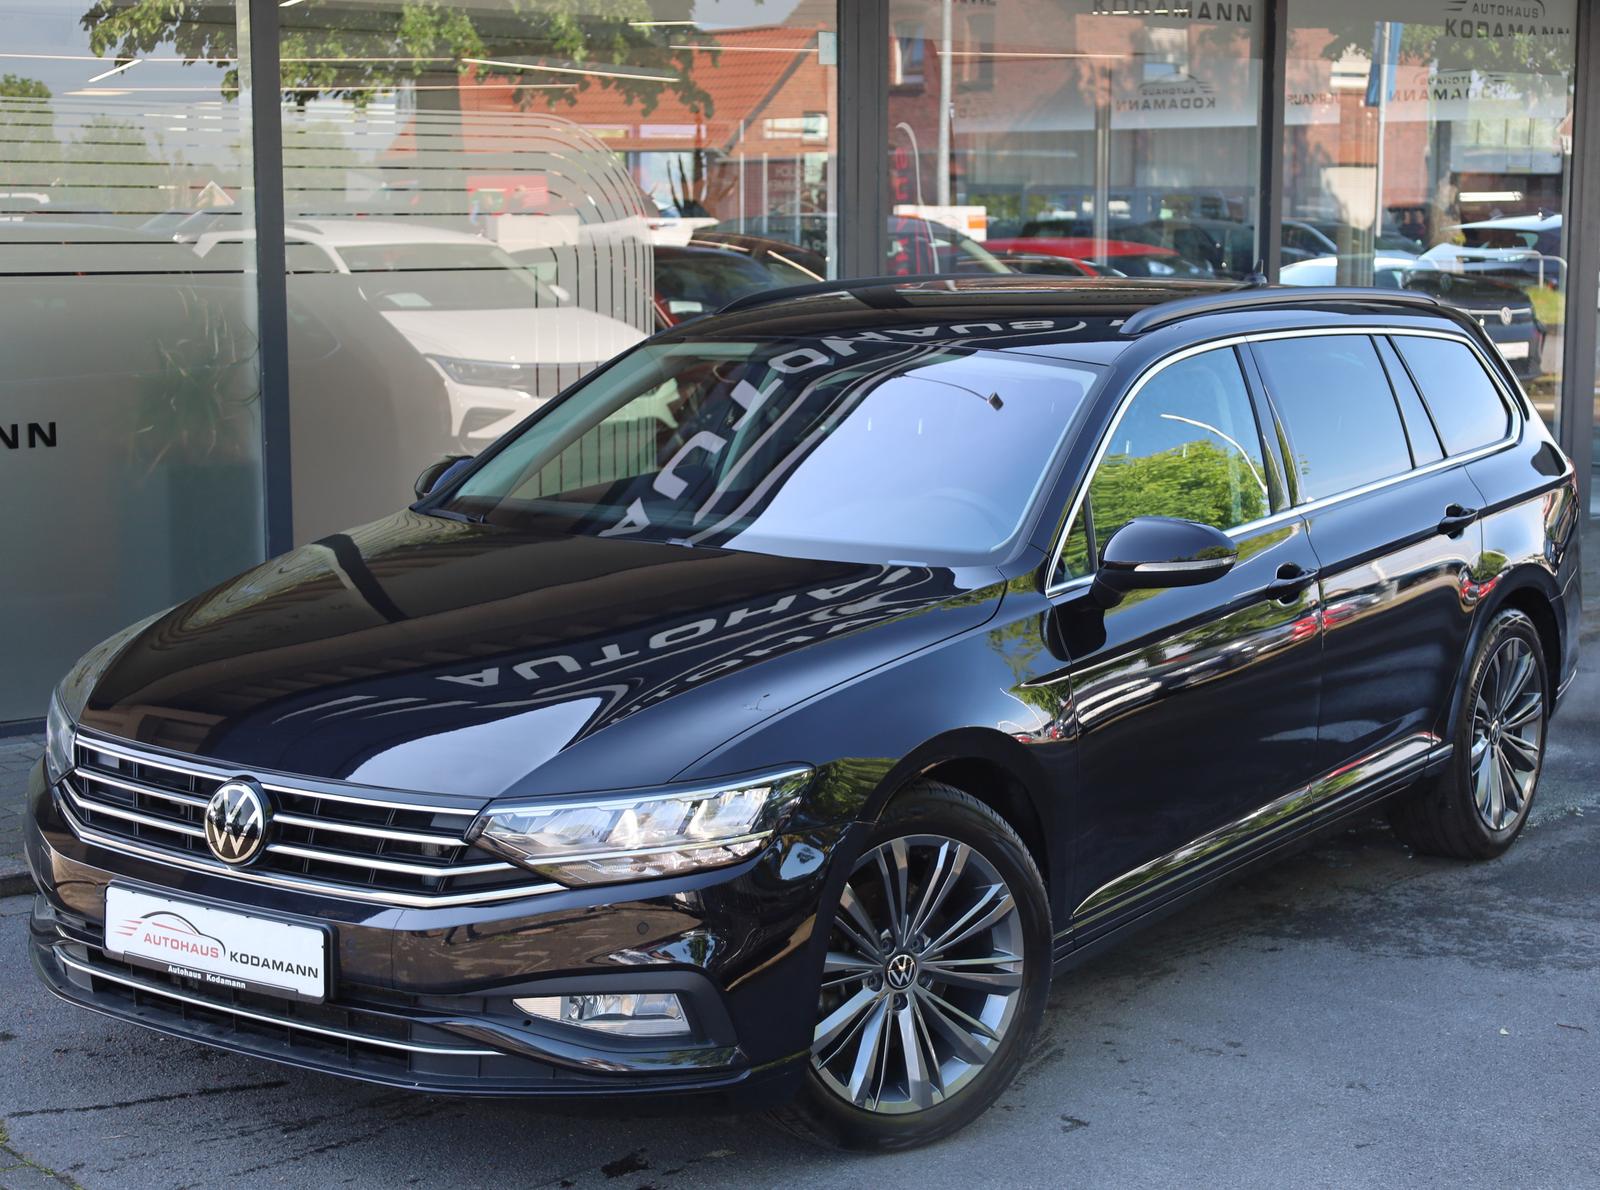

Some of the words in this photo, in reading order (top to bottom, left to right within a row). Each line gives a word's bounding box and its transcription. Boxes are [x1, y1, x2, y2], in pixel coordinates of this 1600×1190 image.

[1472, 3, 1539, 18] AUTOHAUS
[144, 932, 219, 958] AUTOHAUS
[230, 951, 318, 978] KODAMANN
[168, 964, 202, 979] Autohaus
[206, 973, 246, 989] Kodamann
